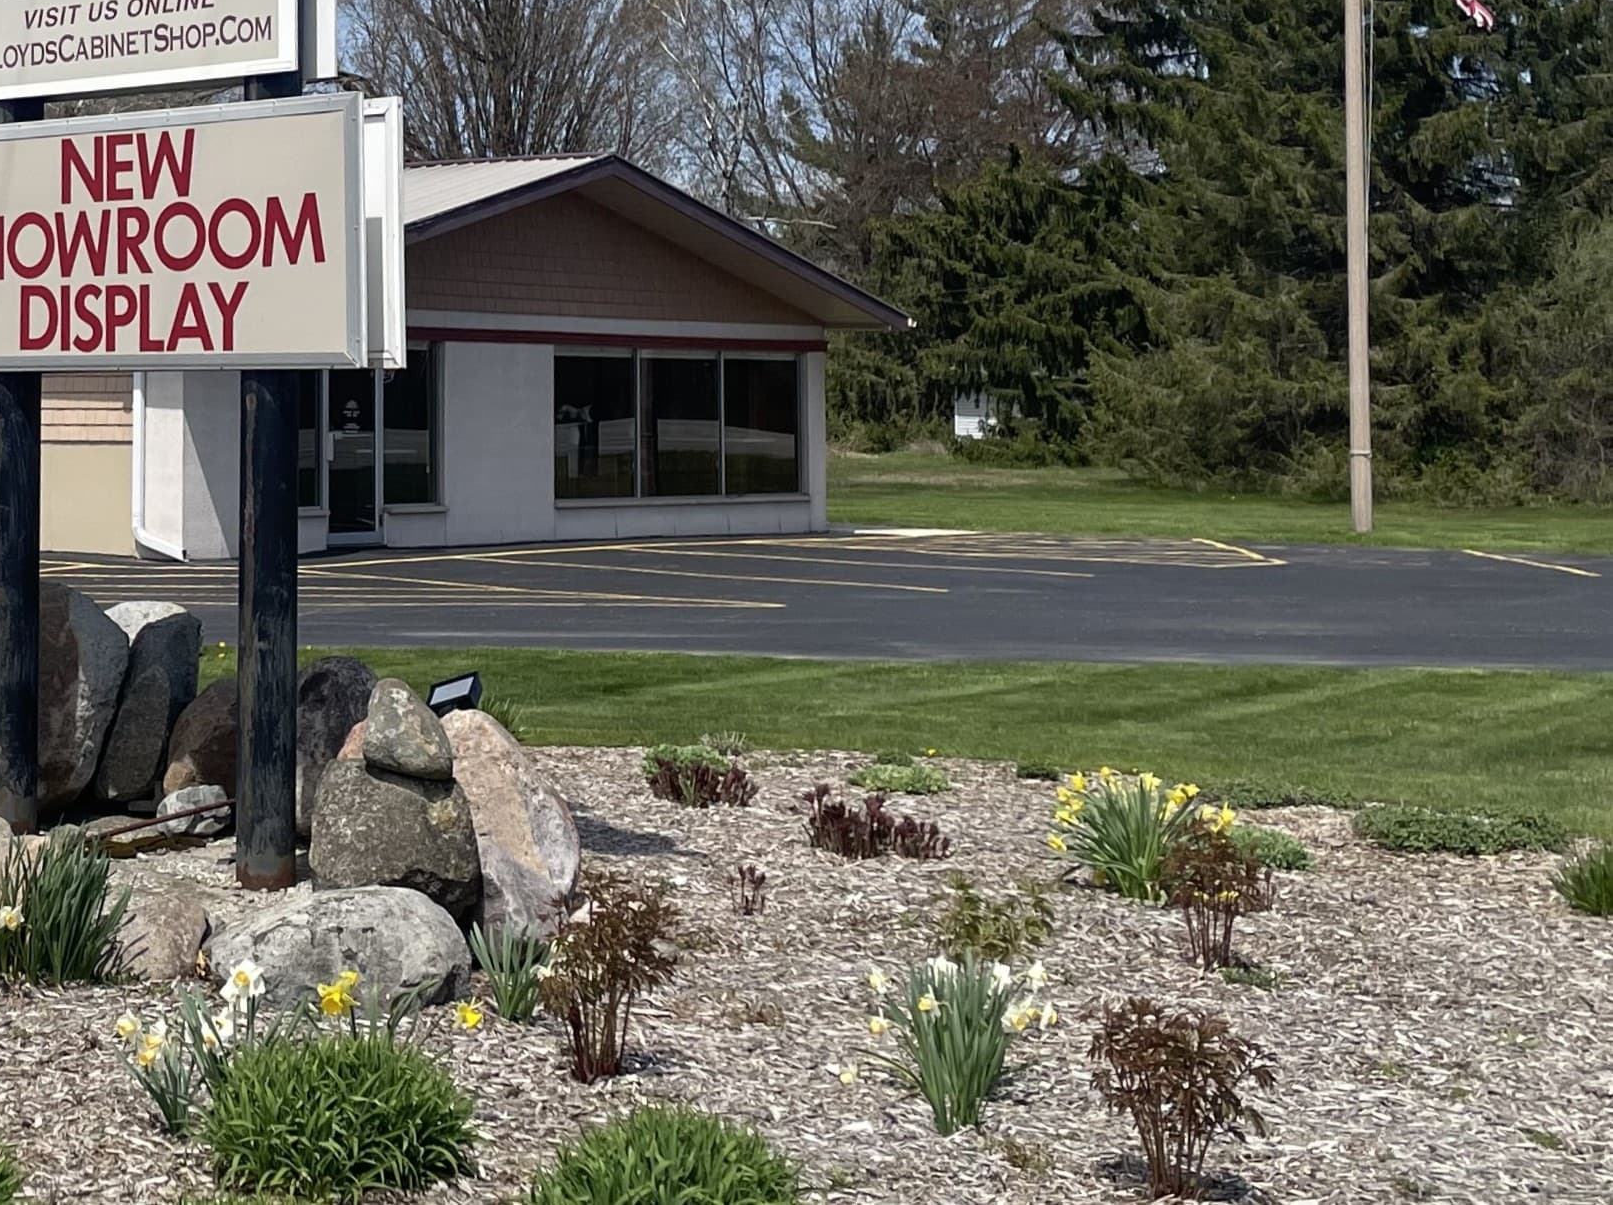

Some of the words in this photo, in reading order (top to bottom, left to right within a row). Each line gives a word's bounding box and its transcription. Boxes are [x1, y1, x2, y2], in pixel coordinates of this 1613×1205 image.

[23, 3, 81, 29] VISIT
[61, 128, 195, 205] NEW
[19, 281, 249, 352] DISPLAY
